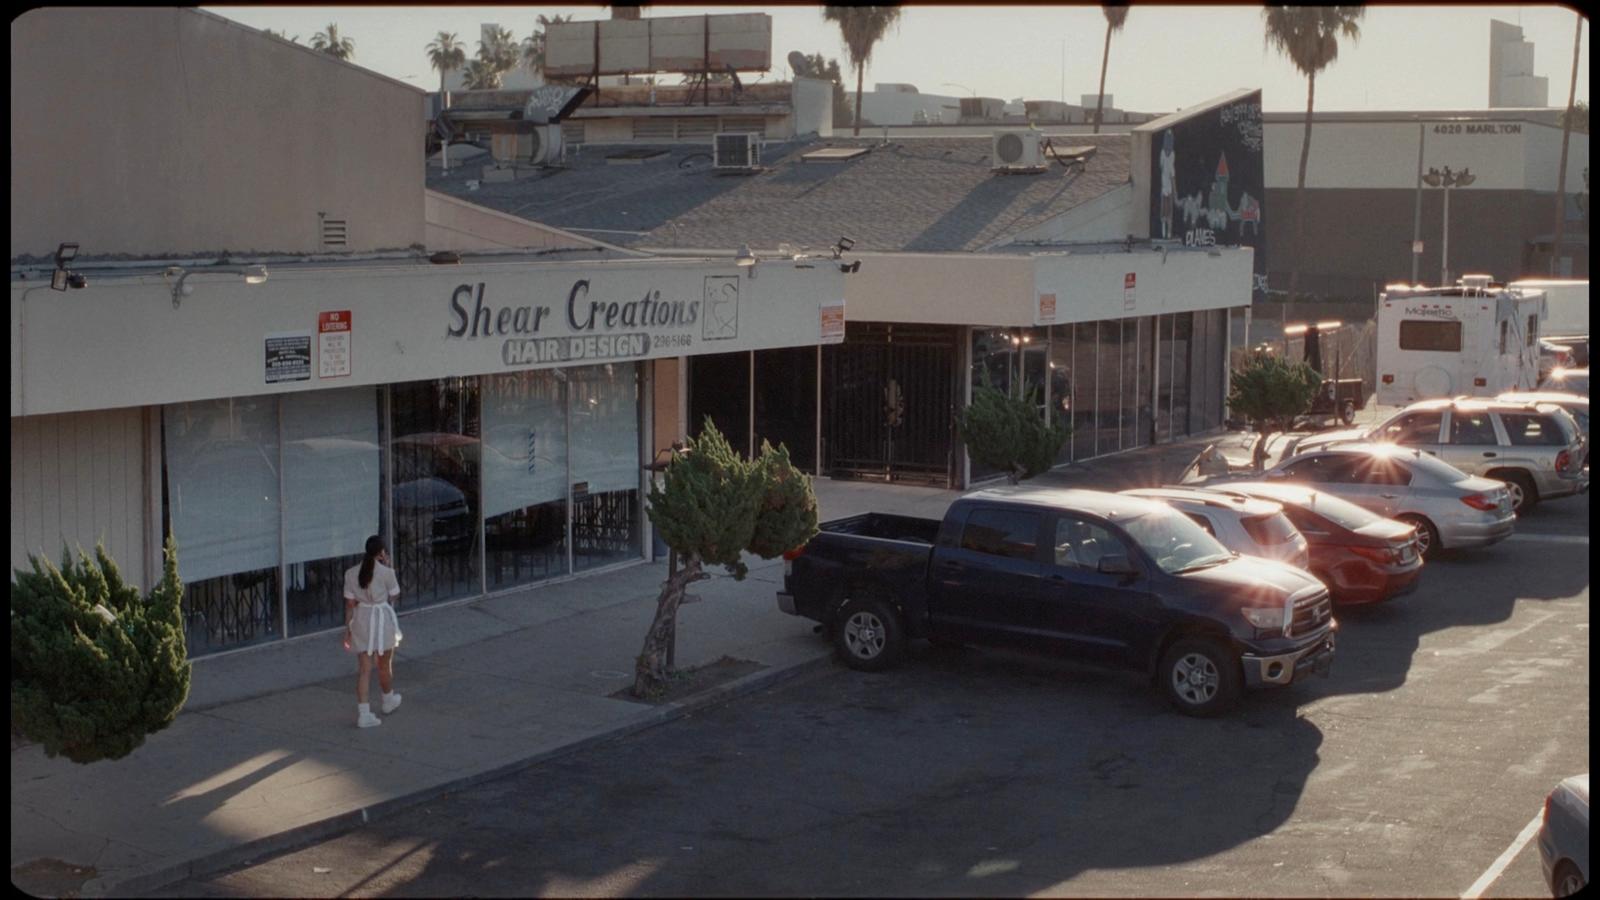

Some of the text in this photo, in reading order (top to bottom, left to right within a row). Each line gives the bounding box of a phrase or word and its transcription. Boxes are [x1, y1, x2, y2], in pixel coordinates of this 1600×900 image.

[1433, 124, 1522, 135] 4020 MARLTON
[448, 279, 700, 336] Shear Creations
[329, 313, 339, 321] NO
[322, 321, 348, 331] LOITERING
[506, 340, 560, 364] HAIR
[569, 334, 645, 360] DESIGN
